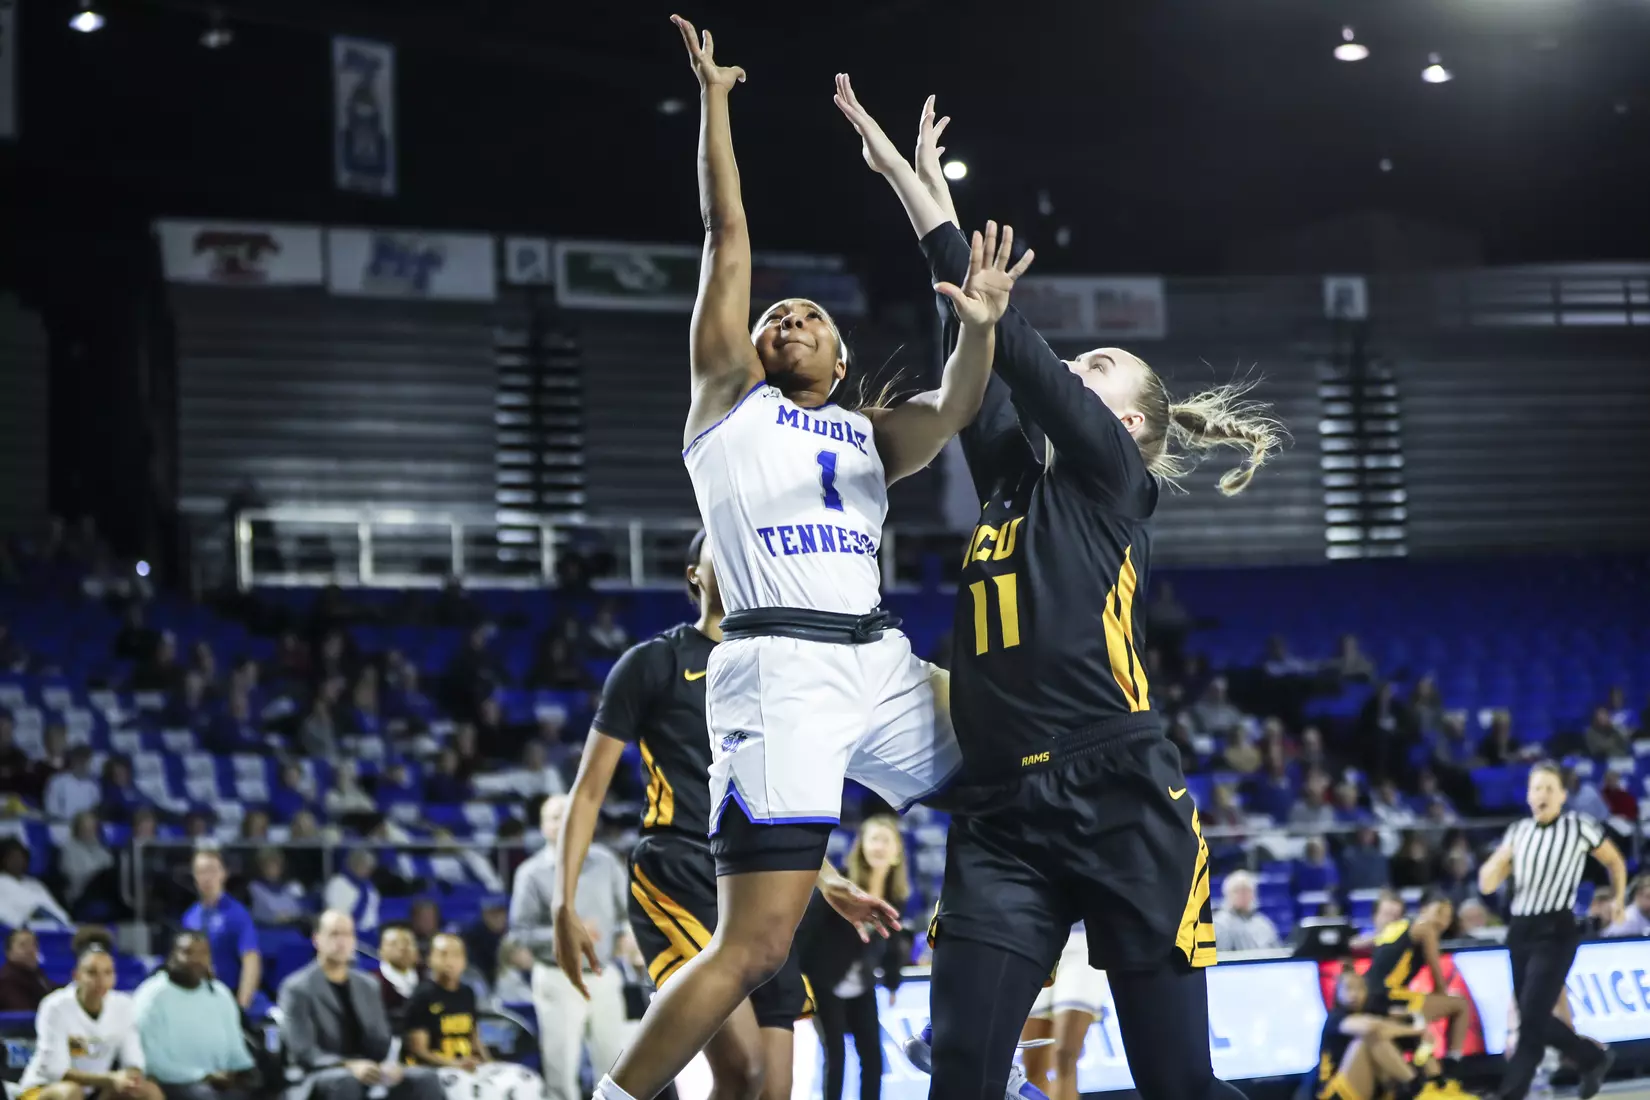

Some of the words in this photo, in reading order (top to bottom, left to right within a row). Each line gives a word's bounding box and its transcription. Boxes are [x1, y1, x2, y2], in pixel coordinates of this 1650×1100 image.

[816, 450, 845, 513] 1
[969, 573, 1020, 656] 11
[1021, 751, 1050, 767] RAMS
